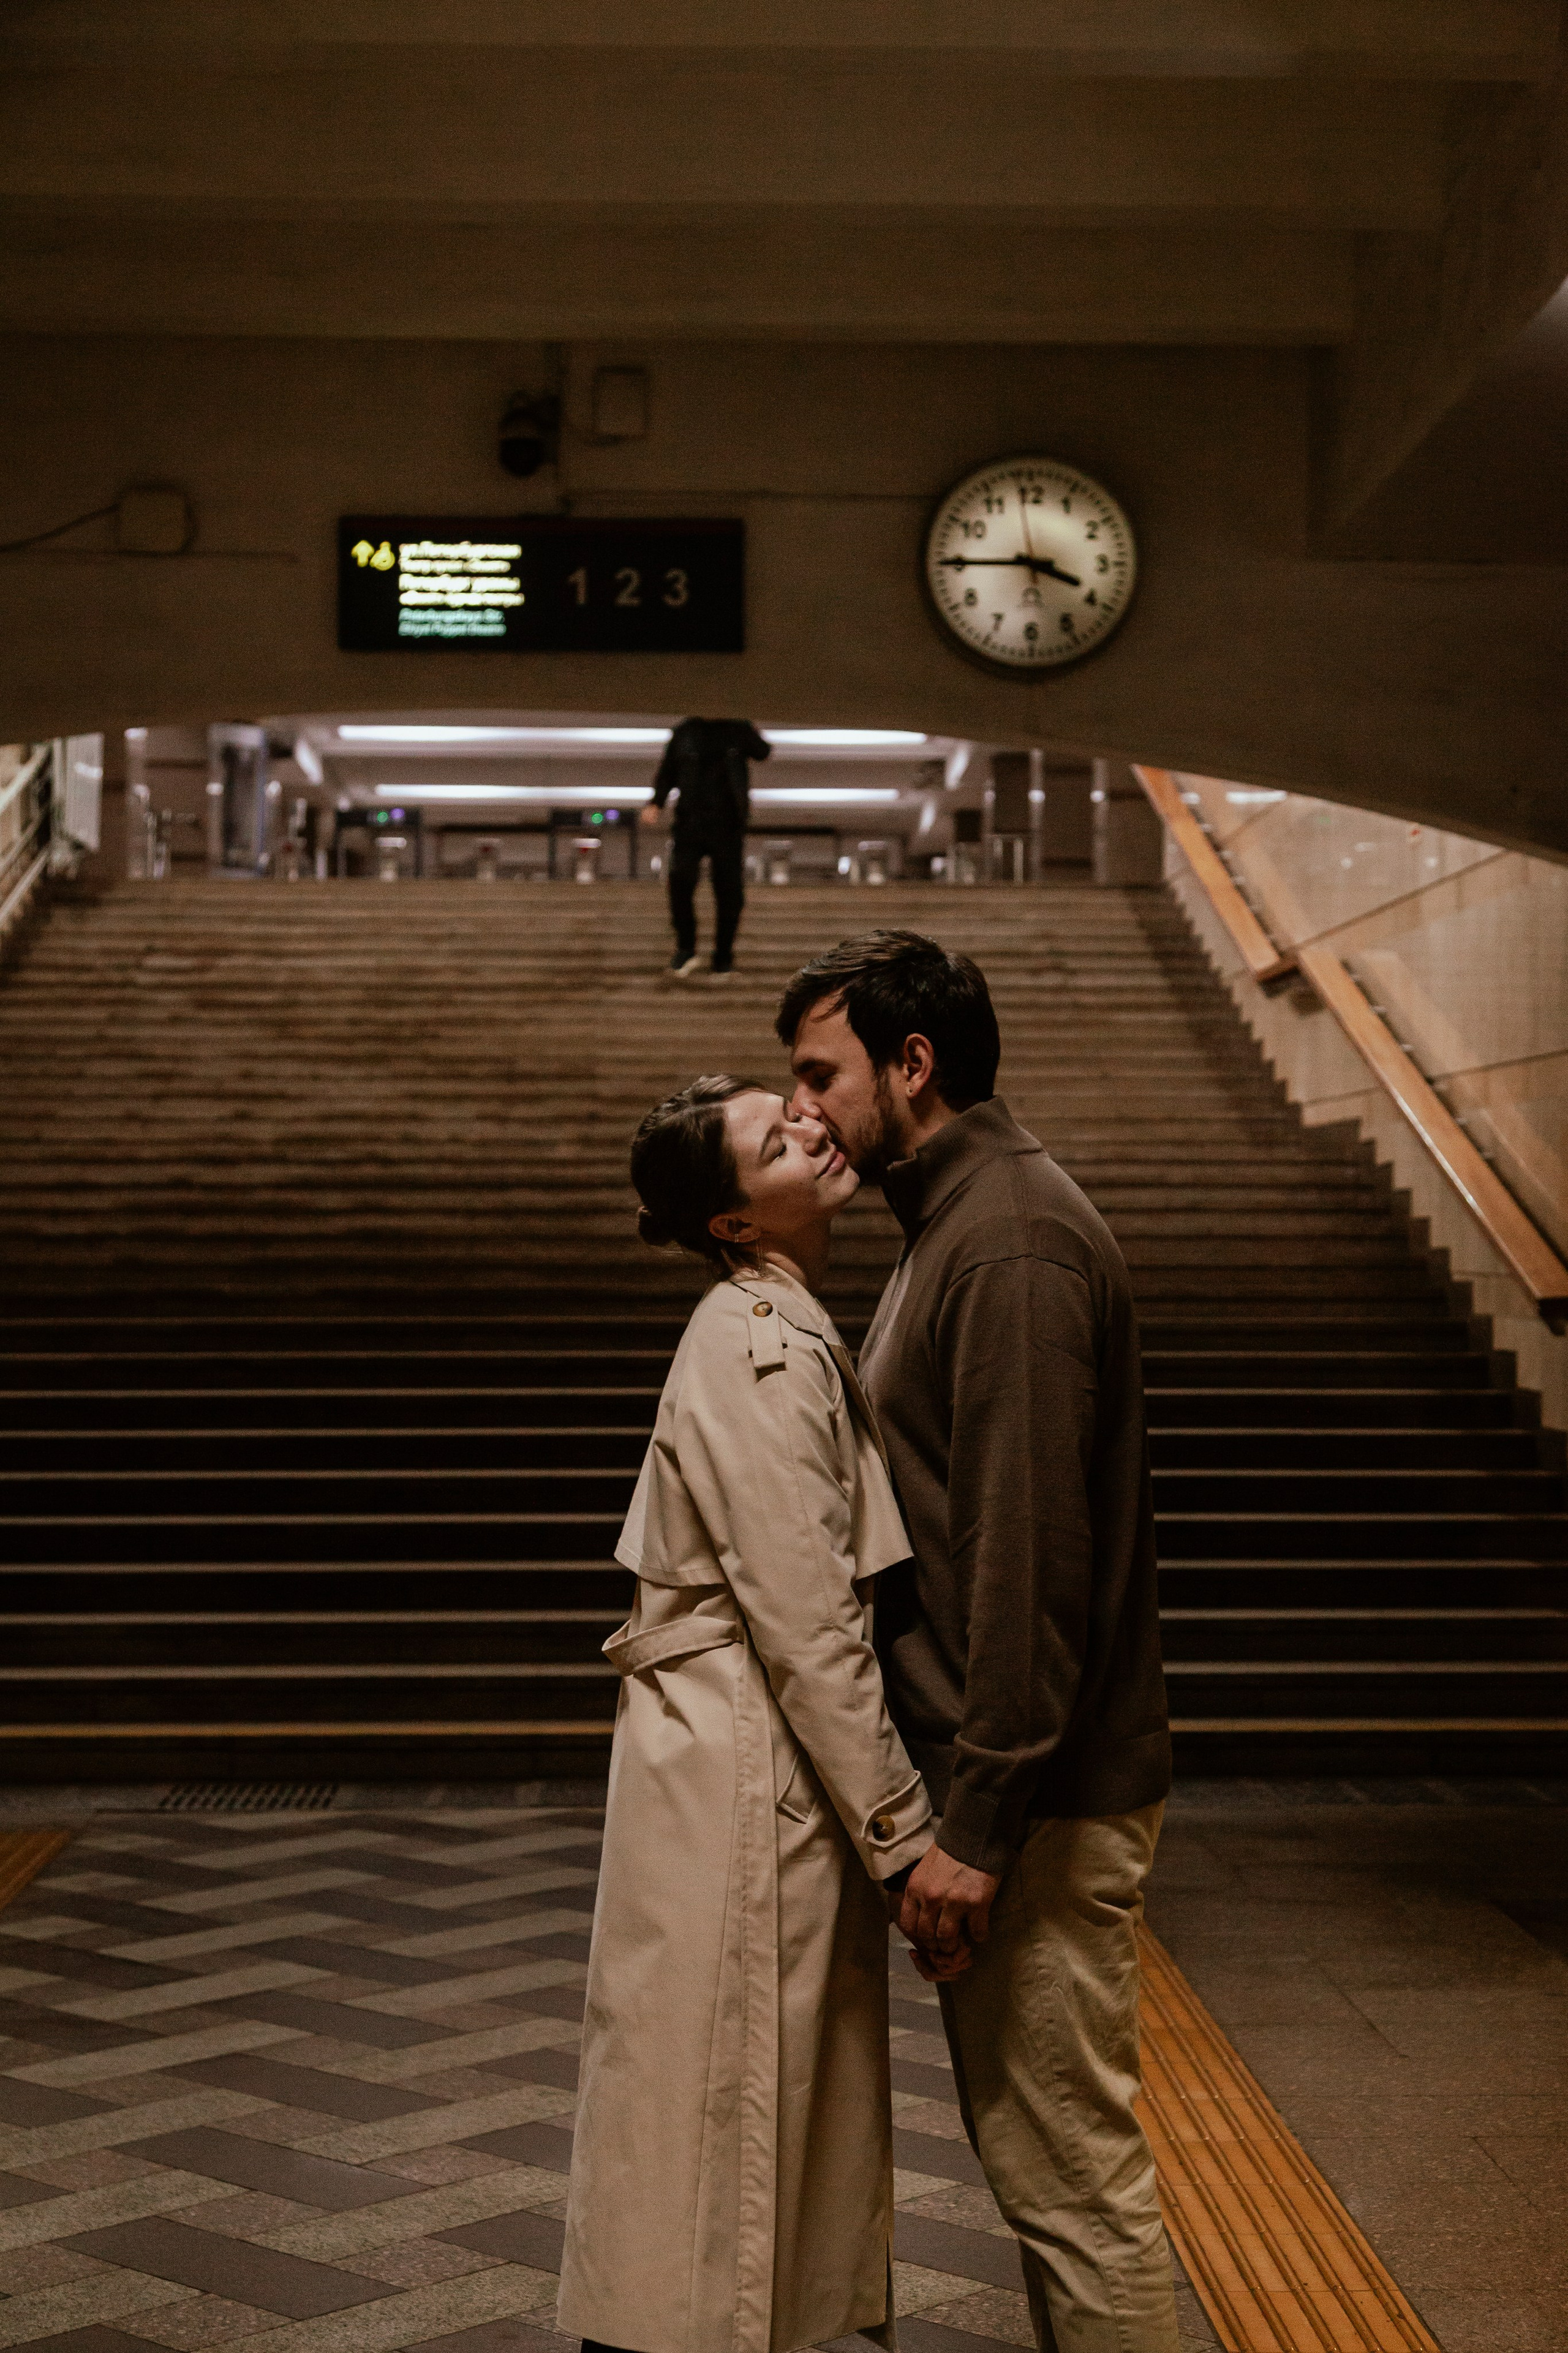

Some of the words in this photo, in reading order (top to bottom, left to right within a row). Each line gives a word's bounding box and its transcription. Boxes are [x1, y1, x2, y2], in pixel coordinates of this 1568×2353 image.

[961, 520, 987, 540] 10
[1085, 520, 1099, 540] 2
[1095, 553, 1110, 575] 3
[567, 566, 589, 605] 1
[614, 566, 642, 606] 2
[663, 566, 690, 606] 3
[963, 587, 979, 607] 8
